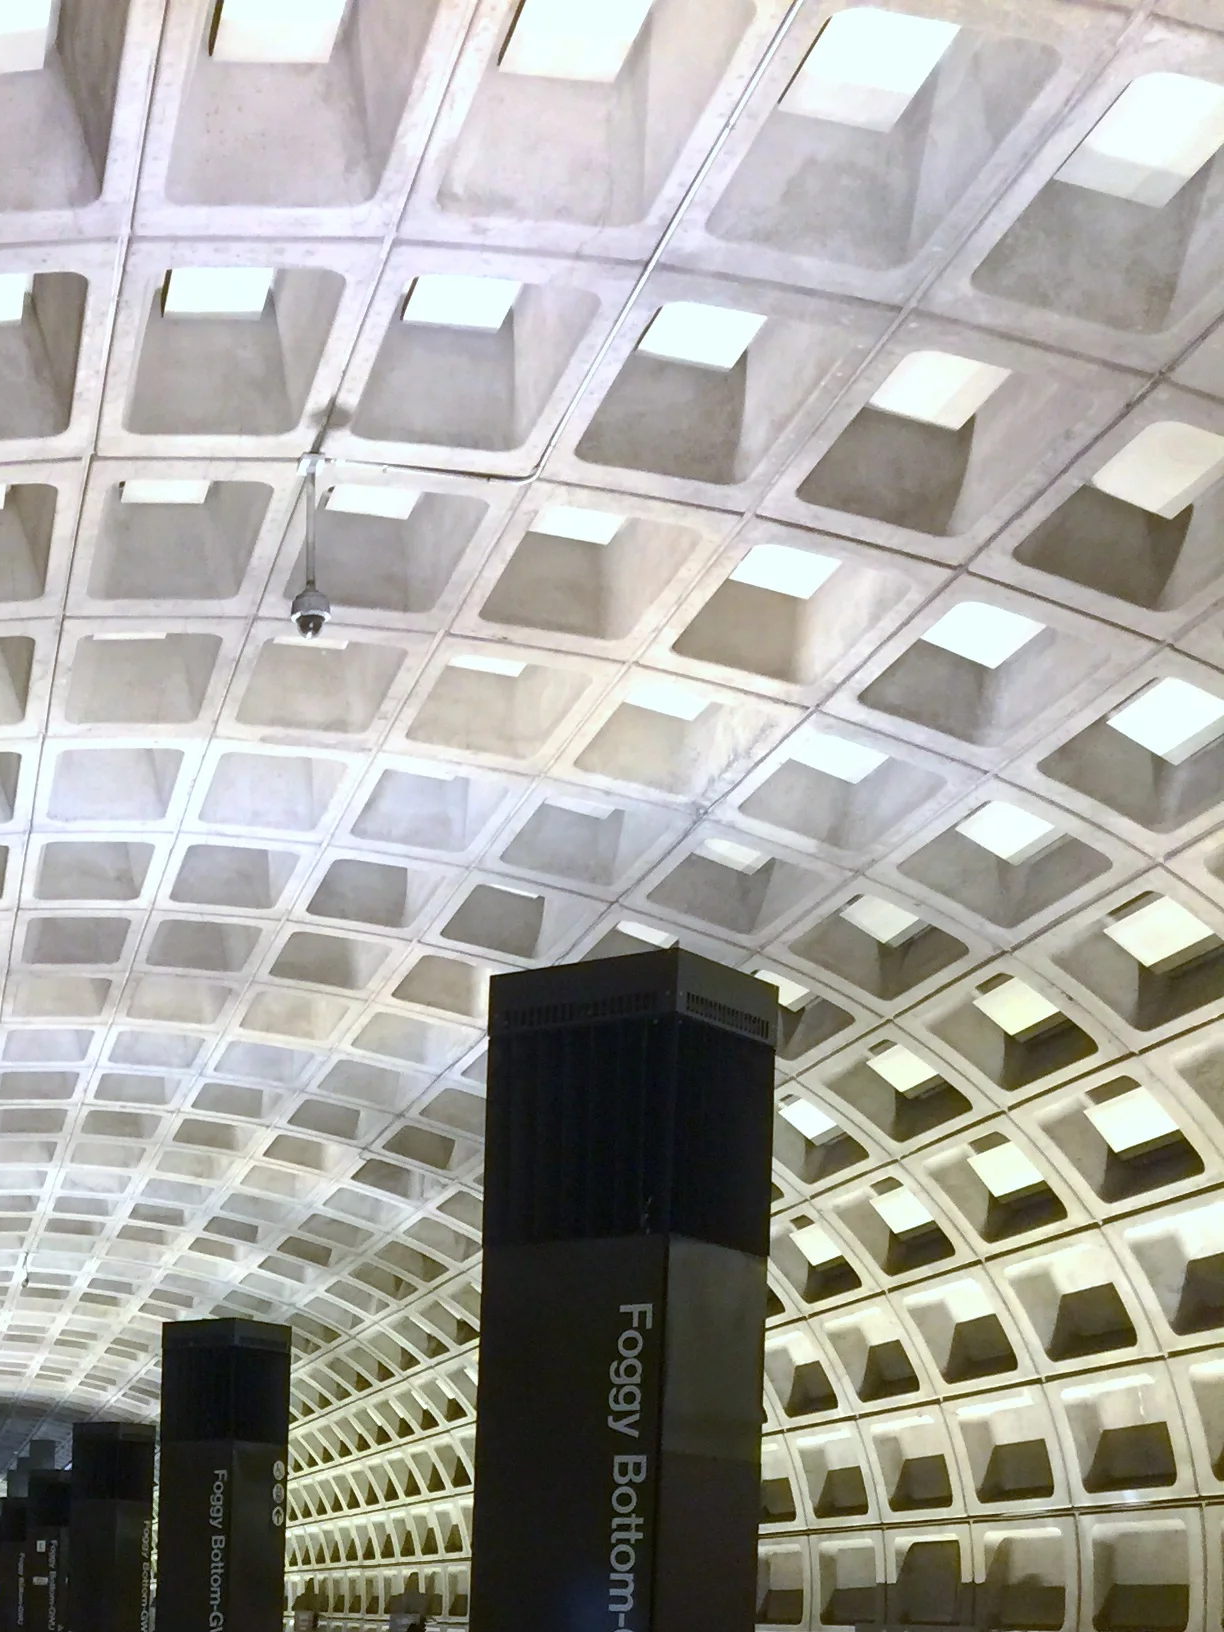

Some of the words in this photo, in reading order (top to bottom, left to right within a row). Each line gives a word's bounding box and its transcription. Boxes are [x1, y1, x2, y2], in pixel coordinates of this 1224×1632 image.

[607, 1303, 653, 1438] Foggy
[209, 1469, 228, 1529] Foggy
[141, 1520, 151, 1559] Foggy
